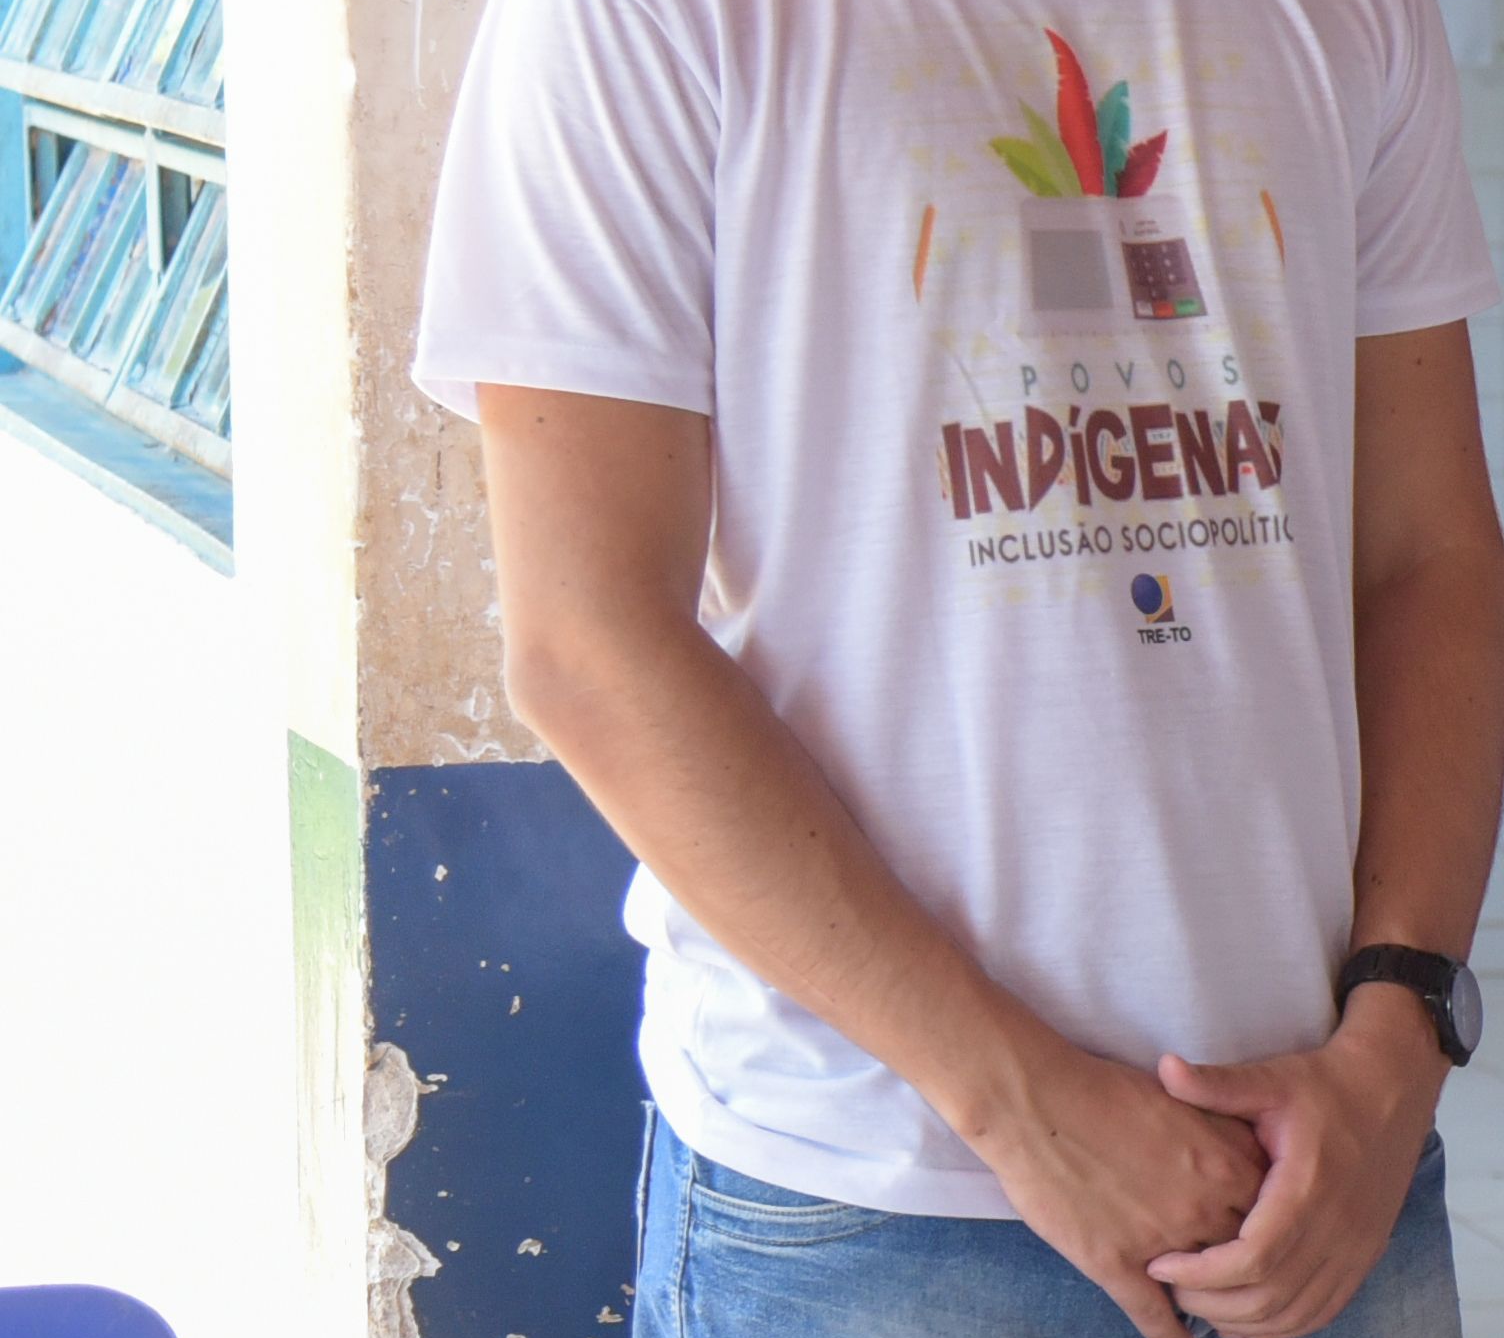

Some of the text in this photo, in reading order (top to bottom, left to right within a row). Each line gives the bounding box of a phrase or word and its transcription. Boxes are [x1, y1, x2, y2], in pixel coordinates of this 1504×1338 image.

[1021, 355, 1240, 396] POVOS
[969, 523, 1112, 568] INCLUSÃO
[1137, 626, 1191, 644] TRE-TO
